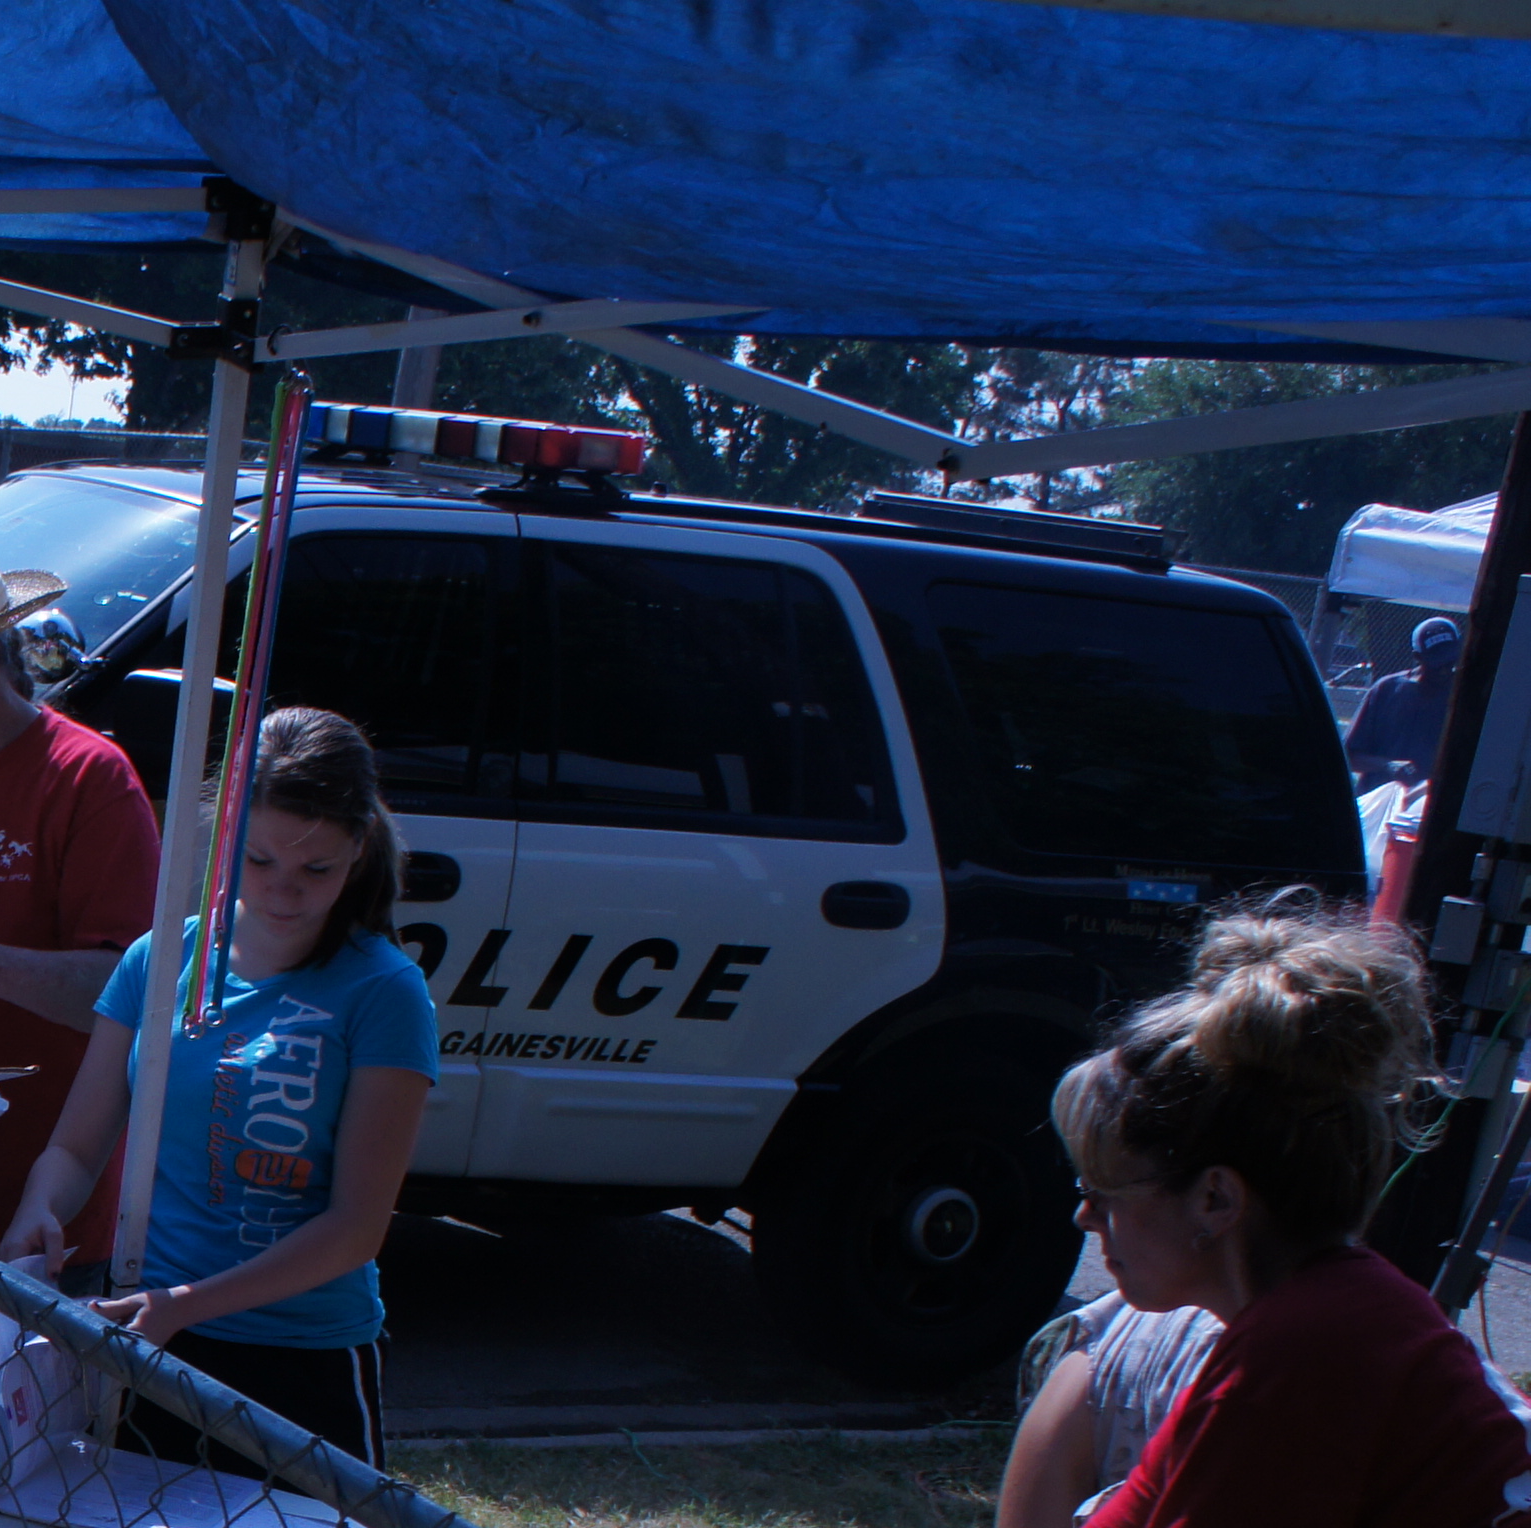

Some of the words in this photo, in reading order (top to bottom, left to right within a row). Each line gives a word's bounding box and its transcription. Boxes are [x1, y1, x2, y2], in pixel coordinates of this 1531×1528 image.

[396, 922, 771, 1021] OLICE
[243, 993, 336, 1154] AERO
[439, 1030, 658, 1064] GAINESVILLE
